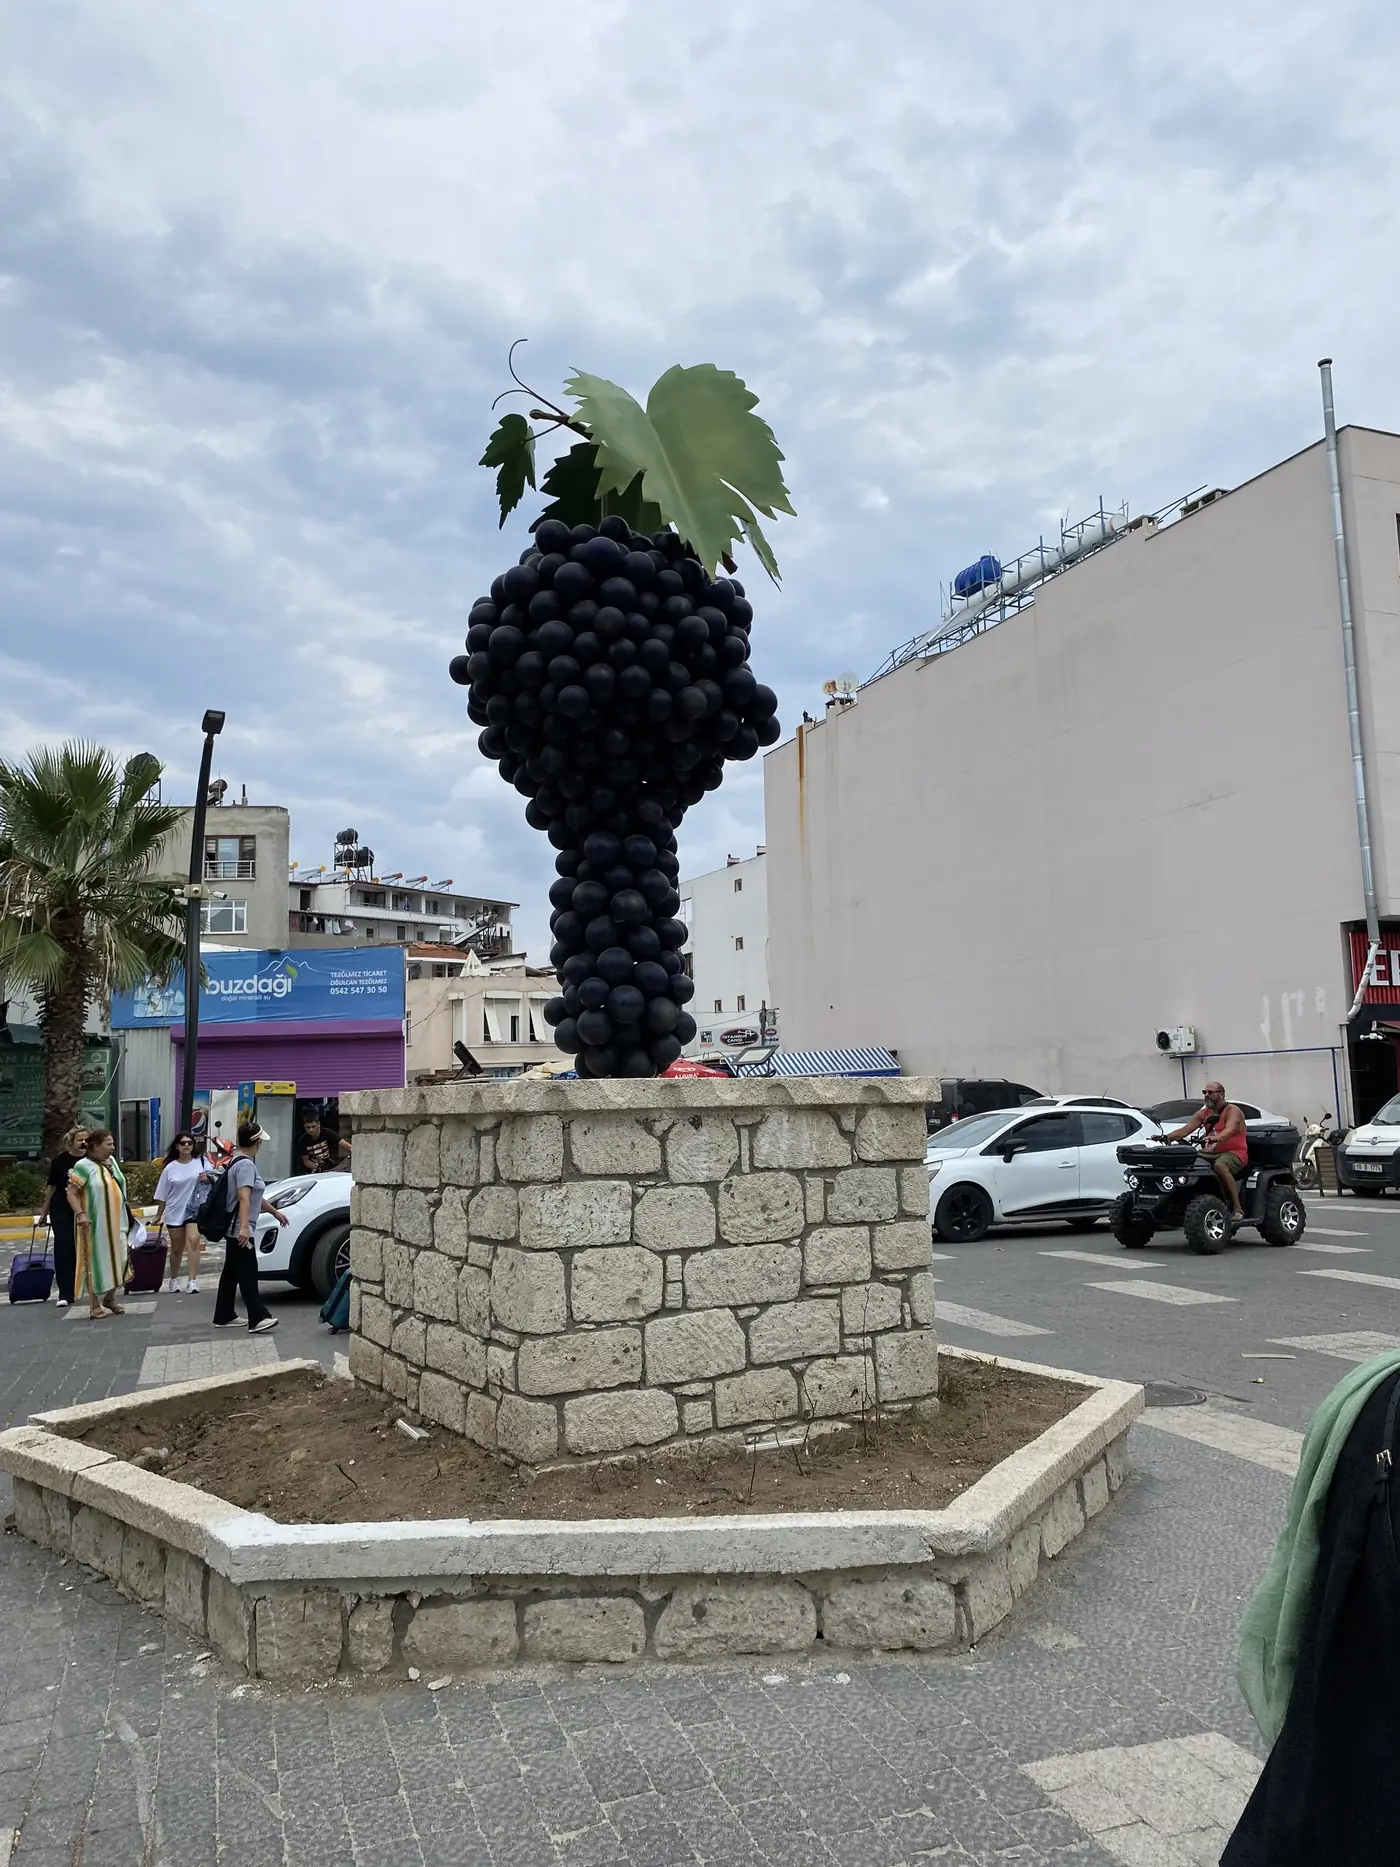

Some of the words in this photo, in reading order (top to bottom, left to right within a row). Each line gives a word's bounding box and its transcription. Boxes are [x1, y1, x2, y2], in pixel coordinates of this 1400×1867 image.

[205, 974, 292, 998] buzdağı
[330, 987, 349, 995] 0542
[350, 986, 365, 994] 547
[366, 986, 376, 994] 30
[378, 985, 388, 993] 50
